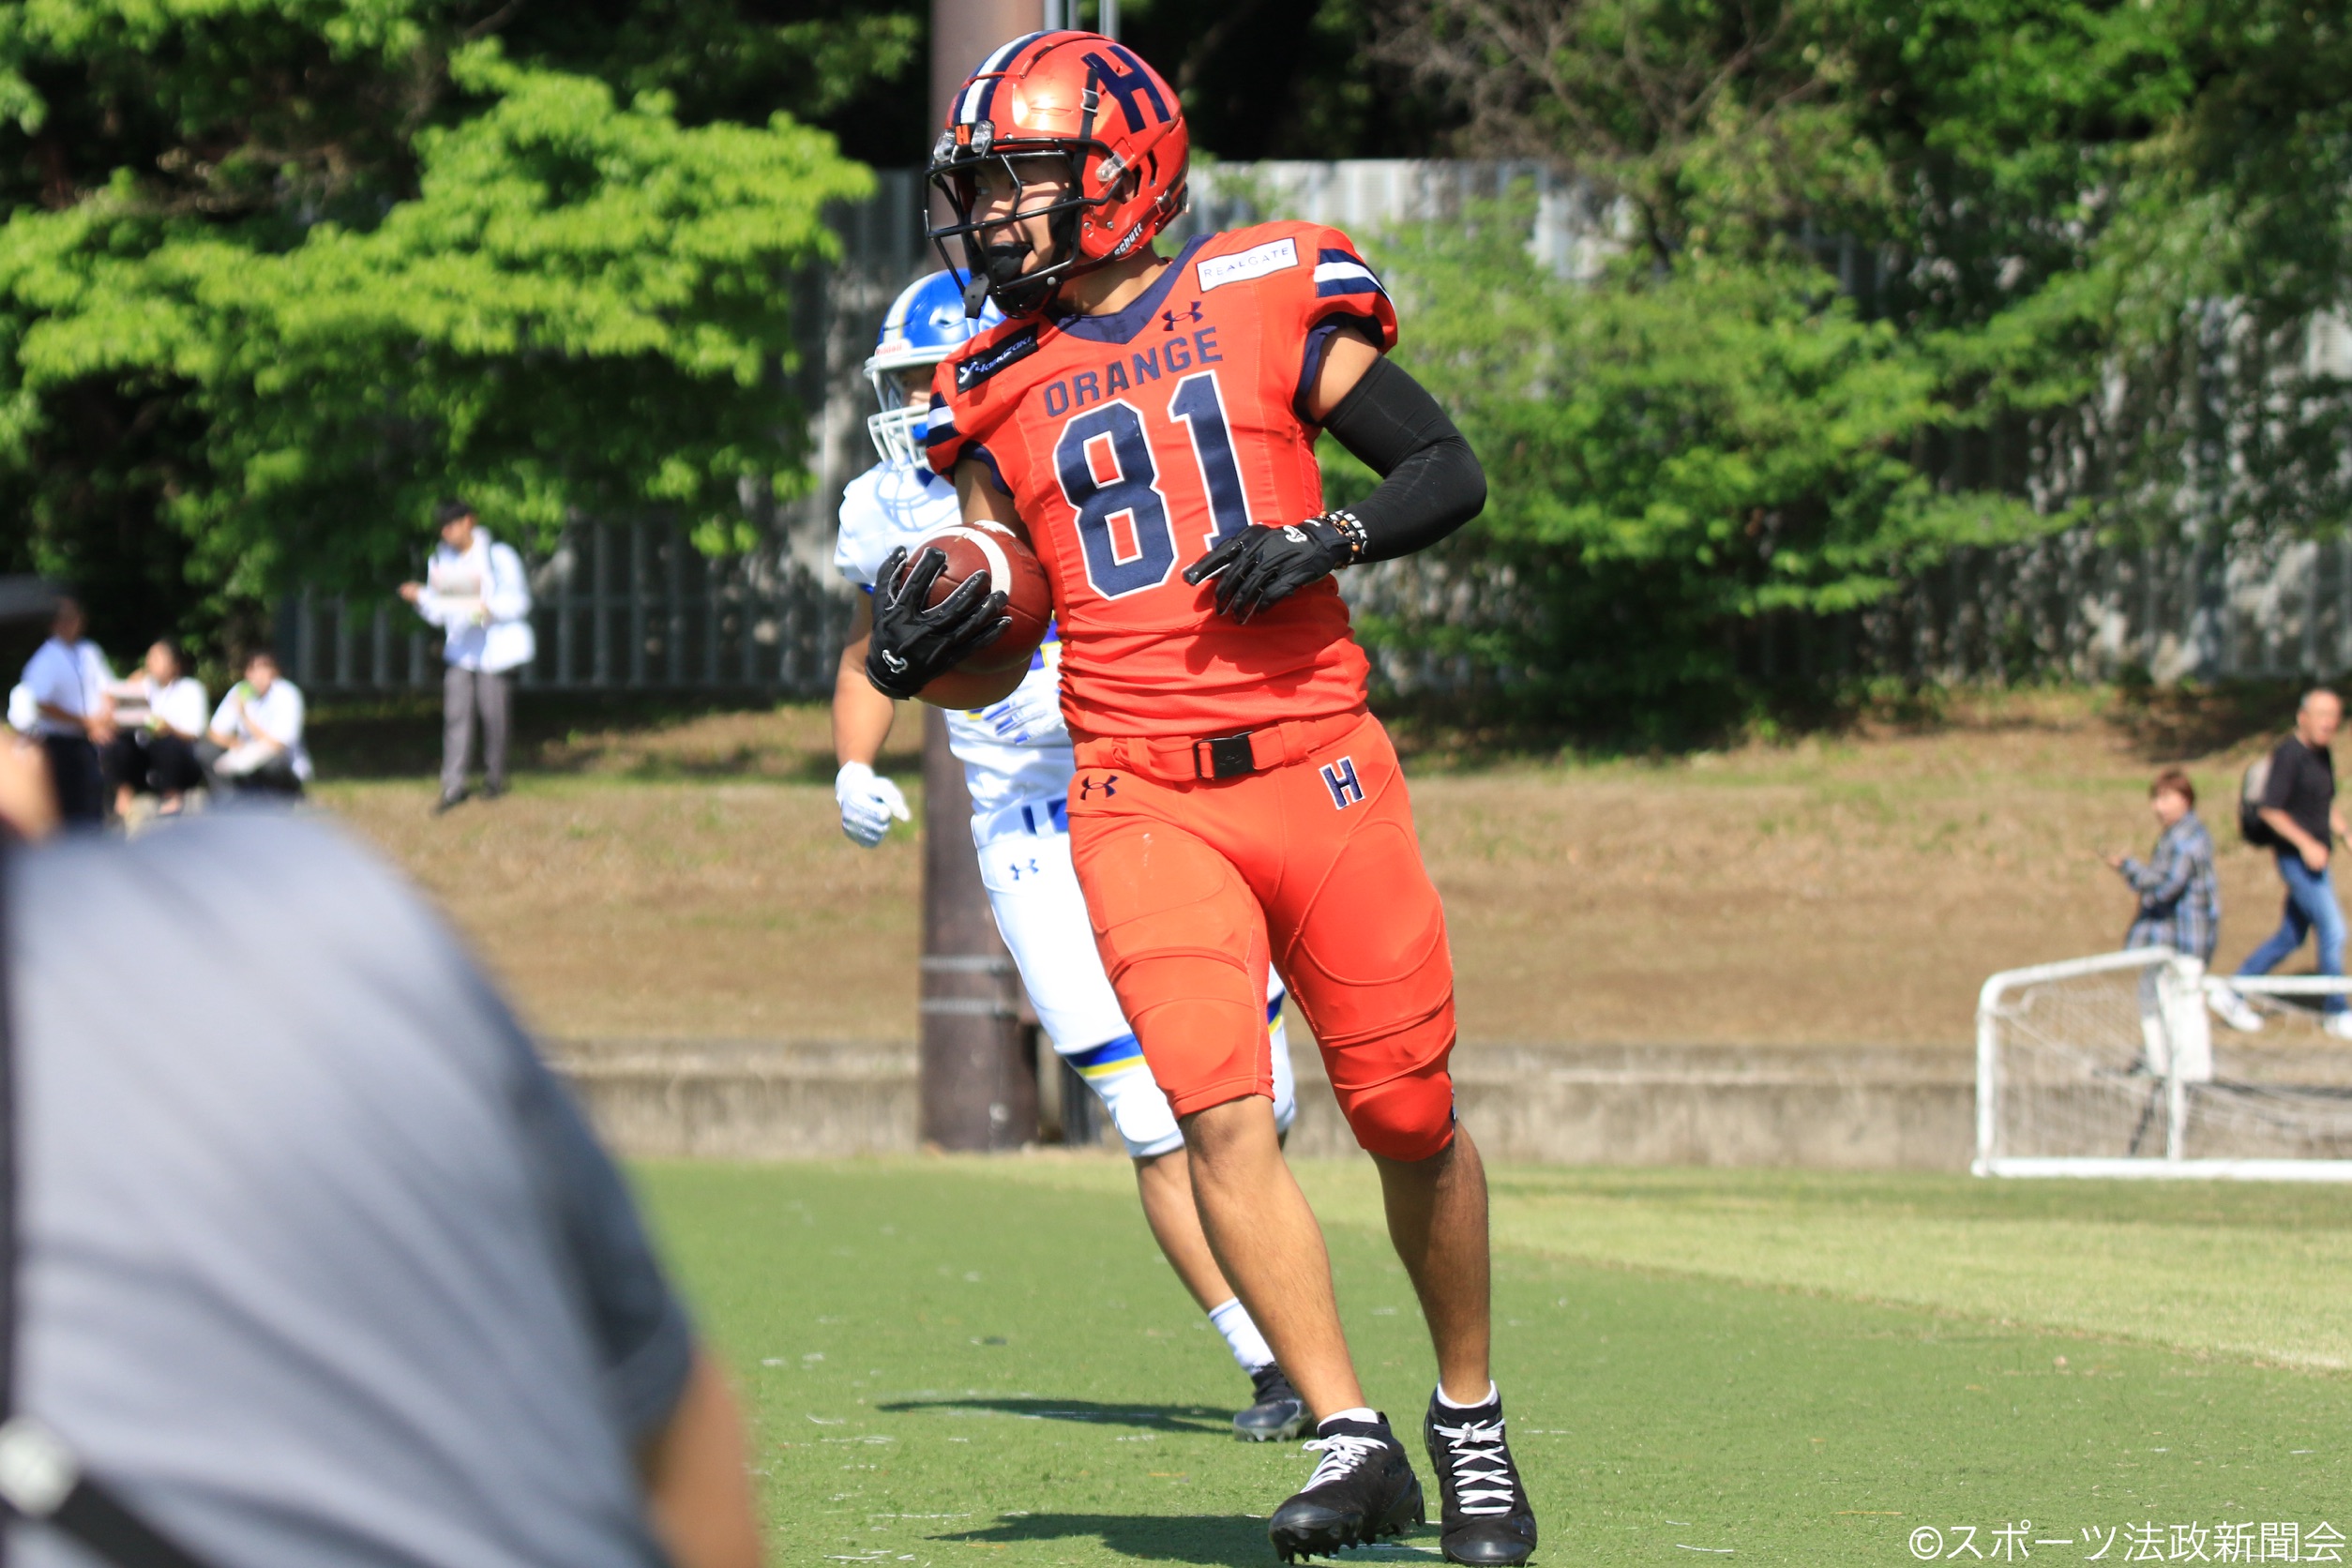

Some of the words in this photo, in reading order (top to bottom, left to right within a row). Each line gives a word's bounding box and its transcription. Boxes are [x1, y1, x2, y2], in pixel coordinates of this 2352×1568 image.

[1079, 44, 1172, 135] H
[1203, 247, 1289, 279] REALGATE
[1043, 325, 1224, 418] ORANGE
[1051, 369, 1254, 602] 81
[1319, 755, 1365, 811] H
